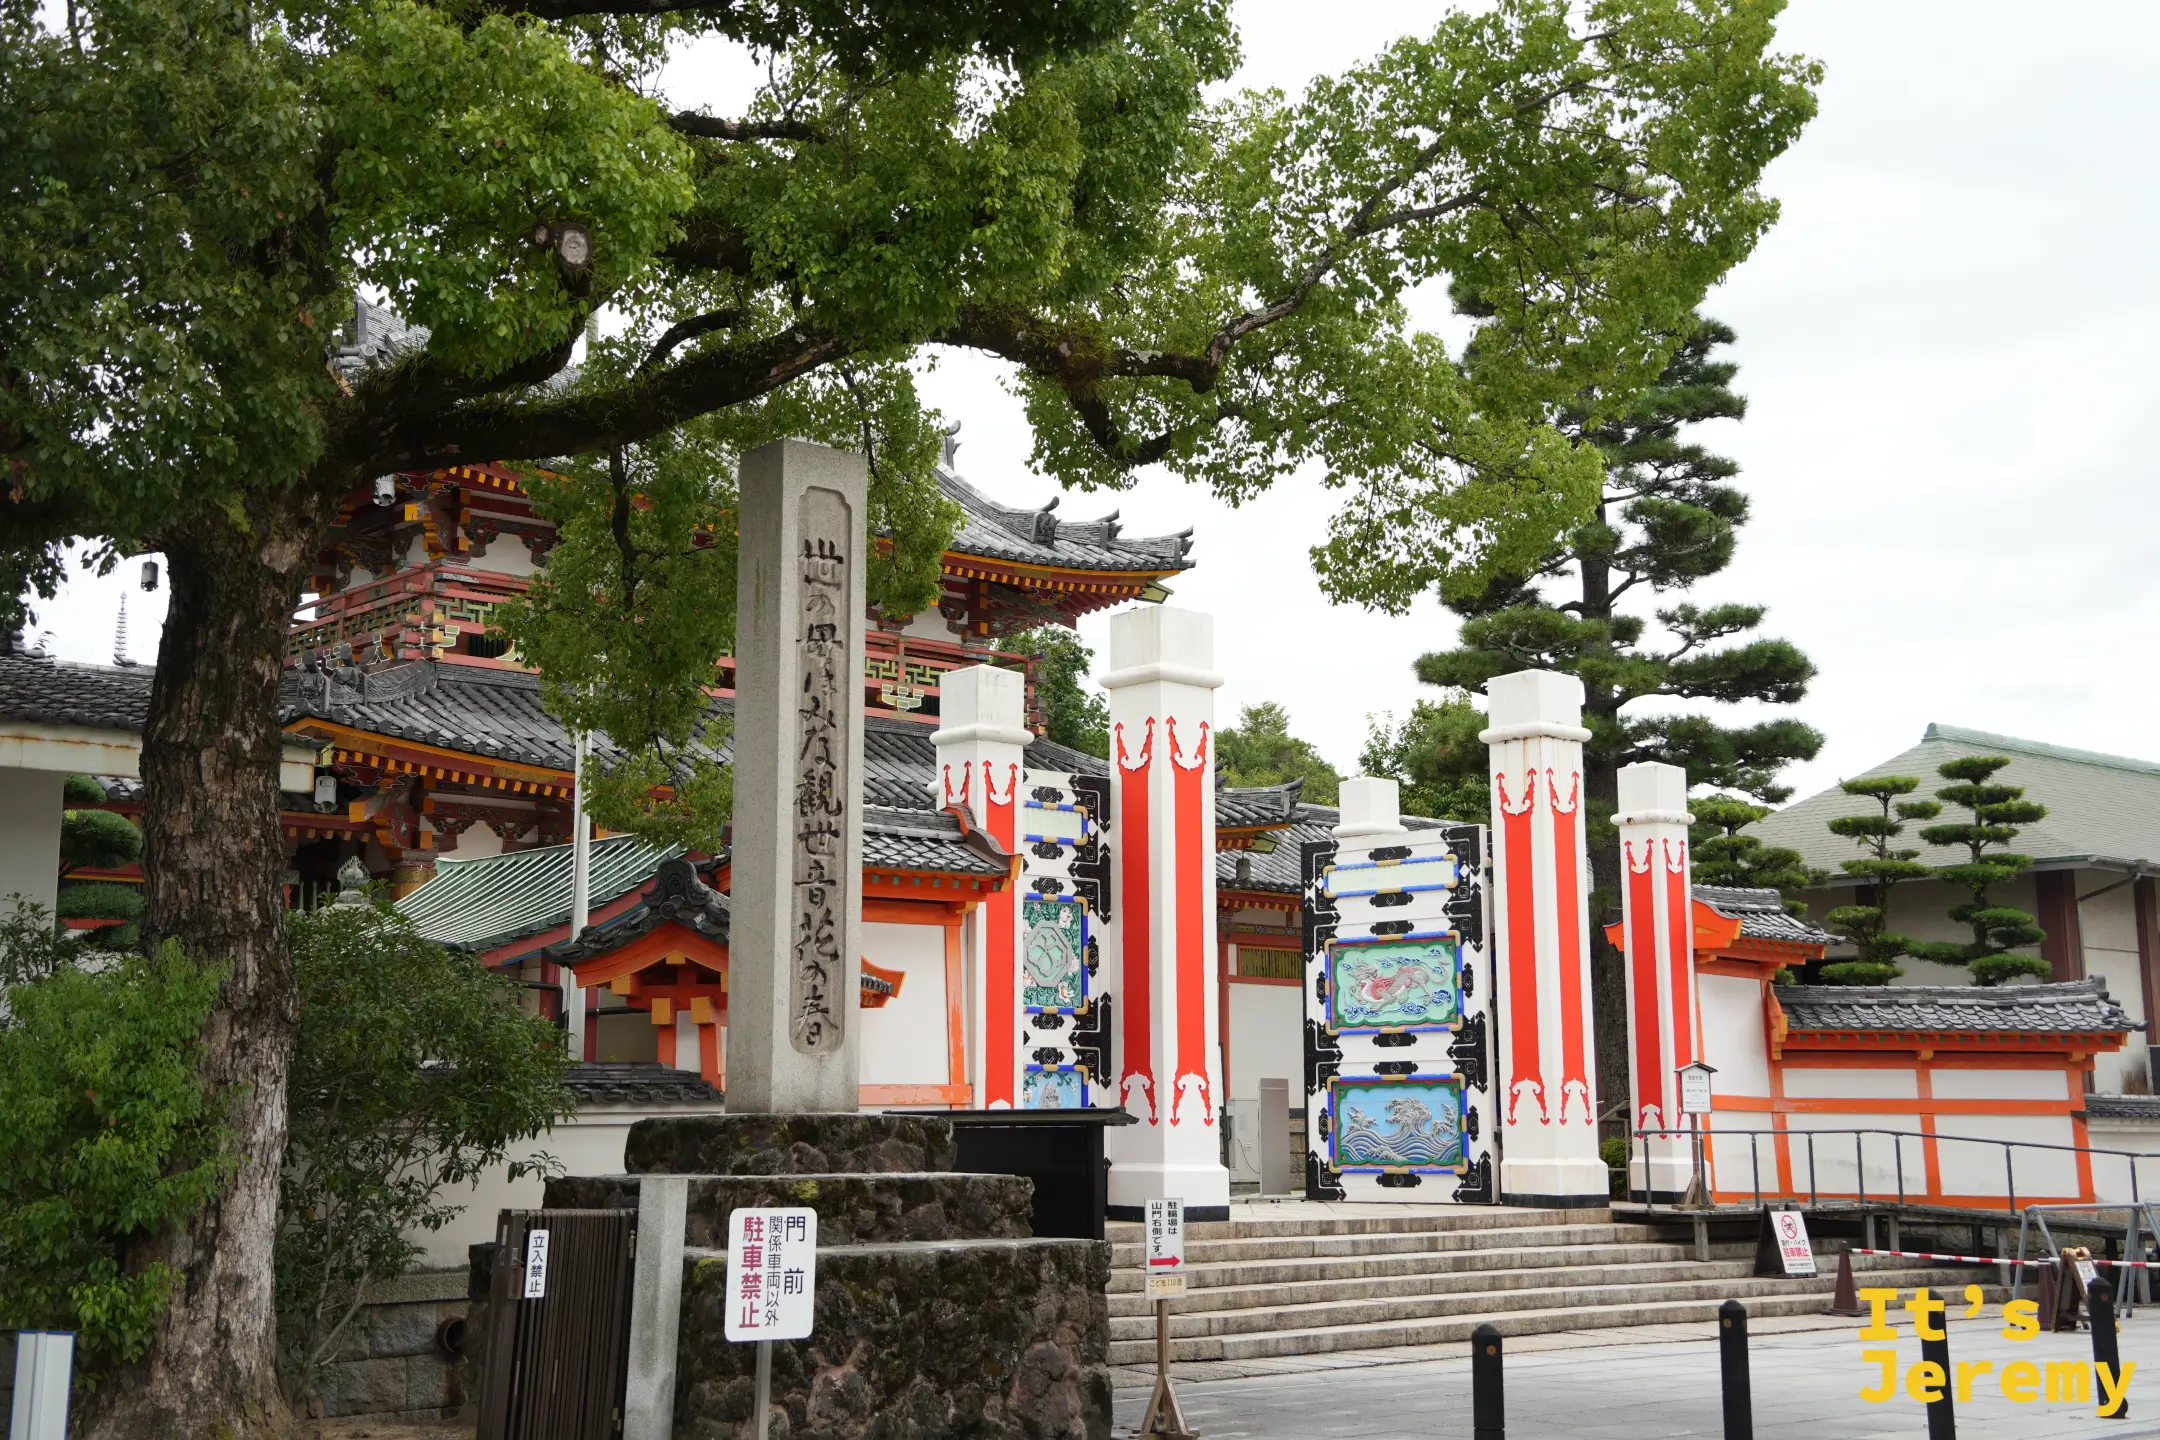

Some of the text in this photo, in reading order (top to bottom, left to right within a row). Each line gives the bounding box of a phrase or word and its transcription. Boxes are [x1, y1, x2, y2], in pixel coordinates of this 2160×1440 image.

[783, 1216, 806, 1295] 門前
[1167, 1201, 1178, 1235] 駐輪場は
[528, 1235, 546, 1294] 立入禁止
[738, 1216, 764, 1329] 駐車禁止
[764, 1216, 783, 1327] 関係車両以外
